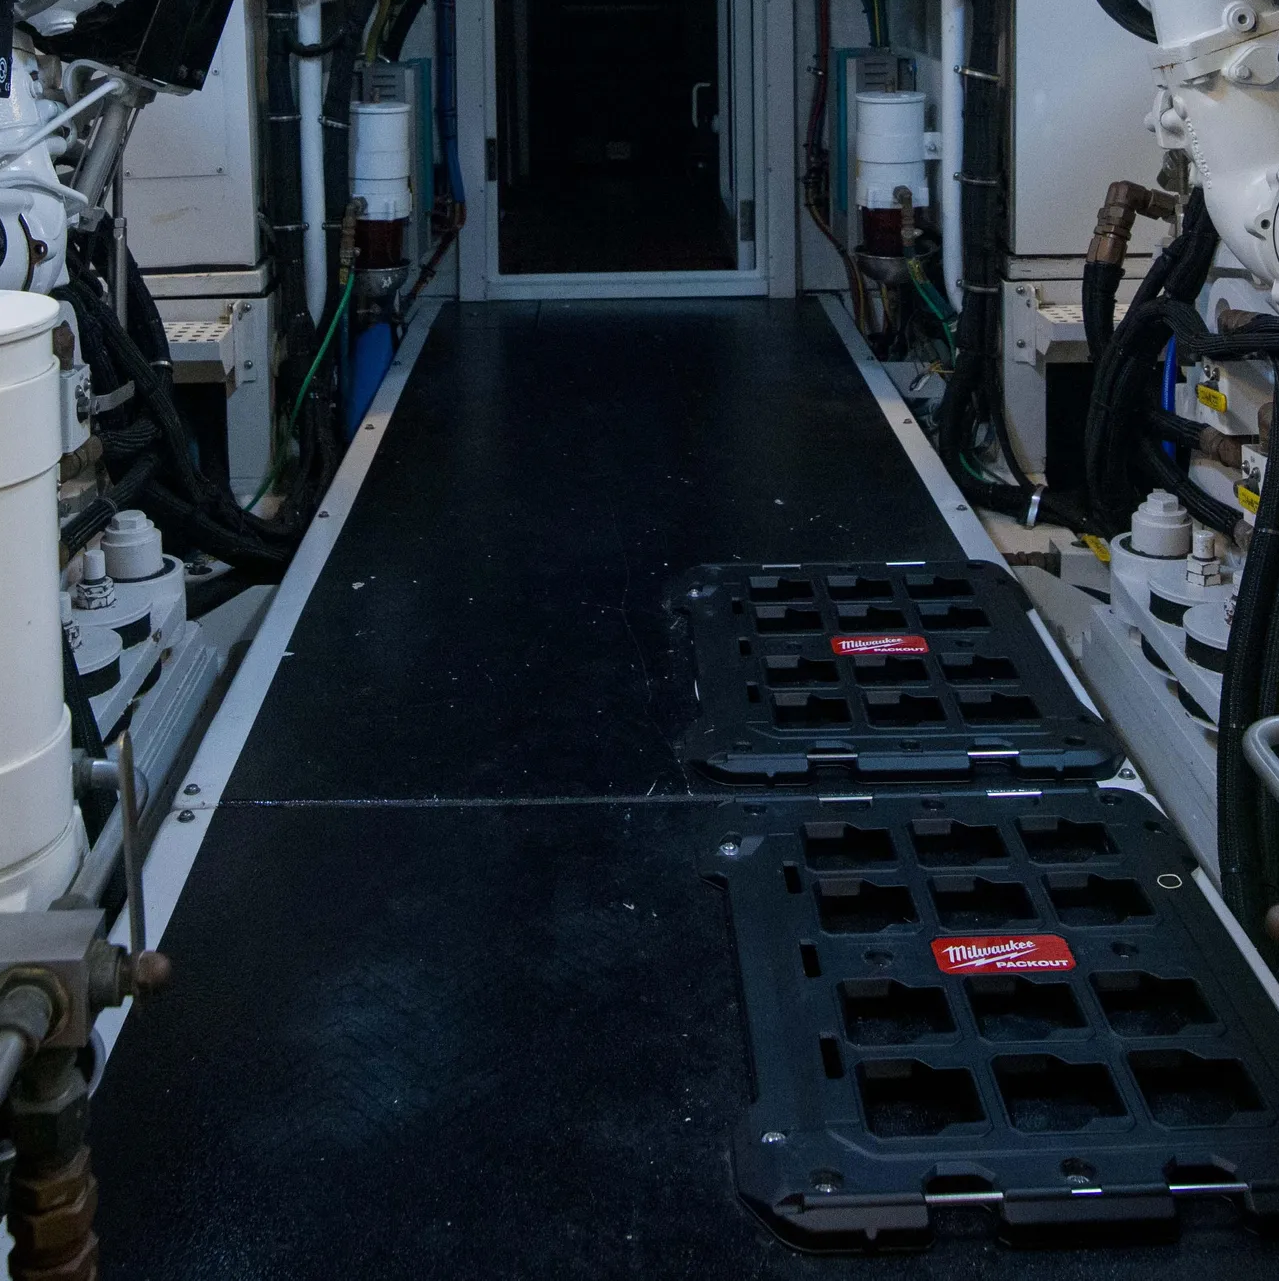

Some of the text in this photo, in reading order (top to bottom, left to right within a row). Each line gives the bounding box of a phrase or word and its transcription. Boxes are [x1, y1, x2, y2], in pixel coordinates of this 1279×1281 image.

[837, 637, 903, 650] Milwaukee
[941, 939, 1036, 963] Milwaukee
[996, 959, 1069, 969] PACKOUT
